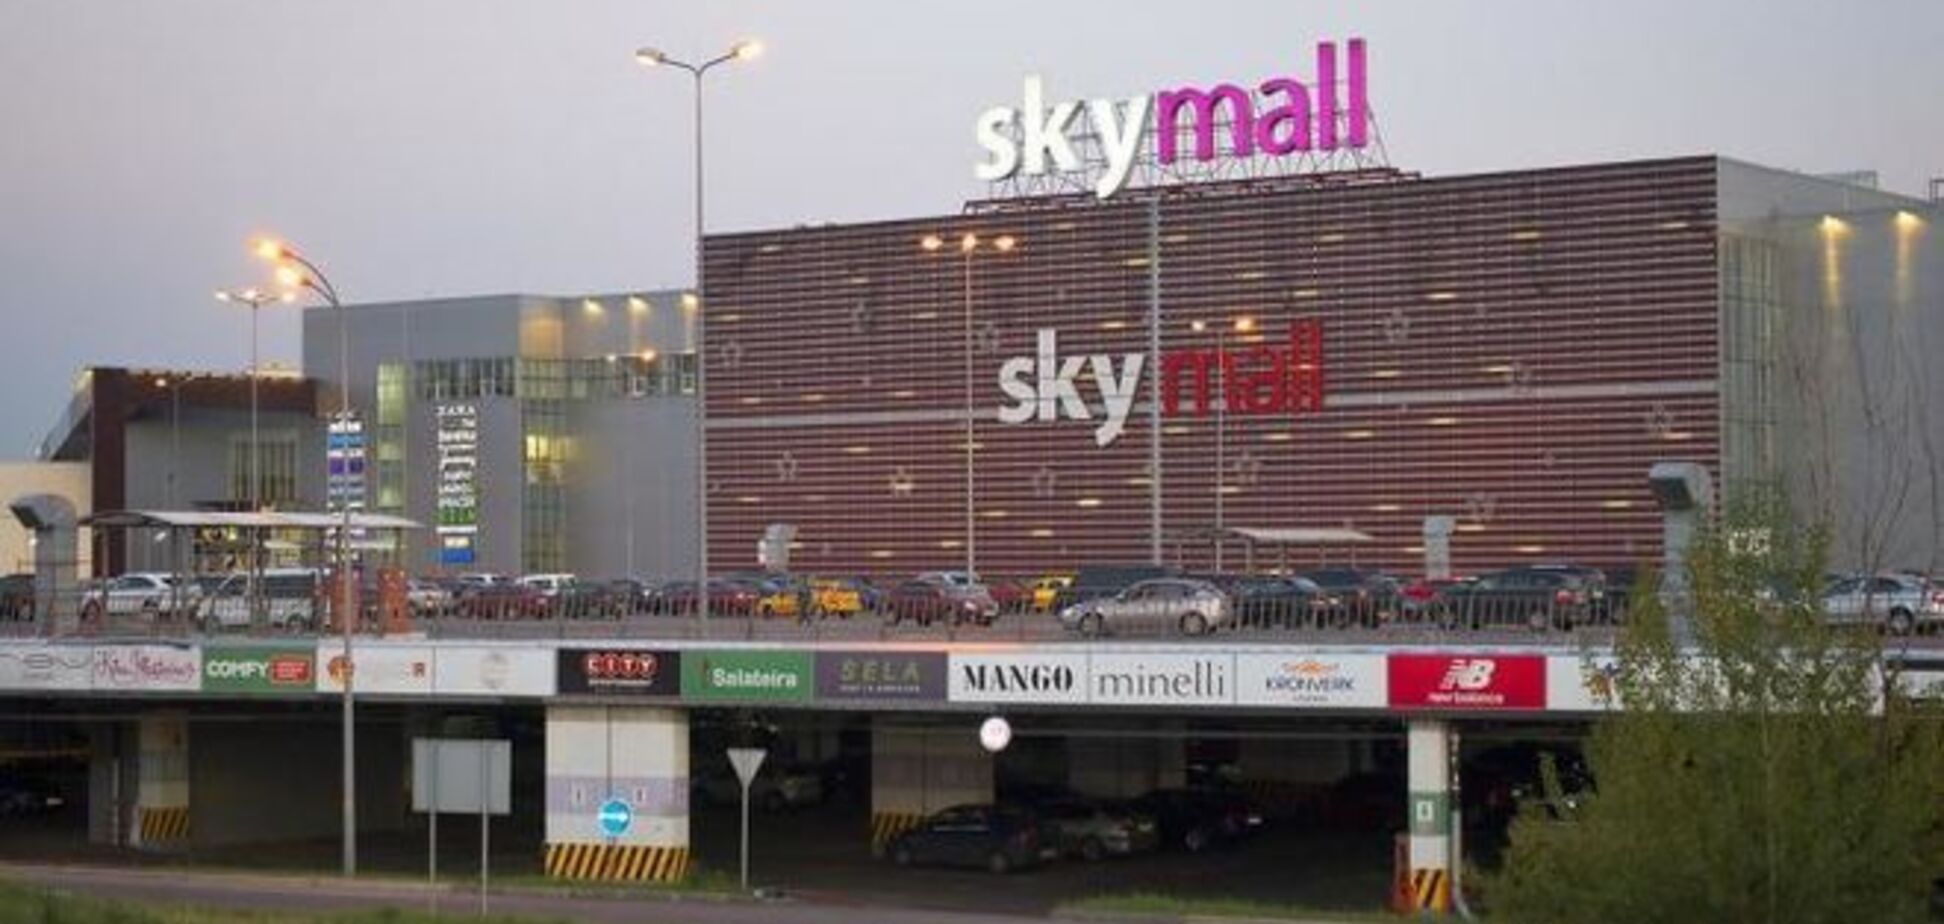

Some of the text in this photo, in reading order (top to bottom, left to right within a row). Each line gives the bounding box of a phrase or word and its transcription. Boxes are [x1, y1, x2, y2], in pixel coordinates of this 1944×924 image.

[206, 660, 268, 678] COMFY
[587, 655, 655, 675] CITY
[840, 661, 919, 681] SELA
[712, 668, 797, 687] Salateira
[964, 665, 1073, 691] MANGO
[1099, 662, 1225, 696] minelli
